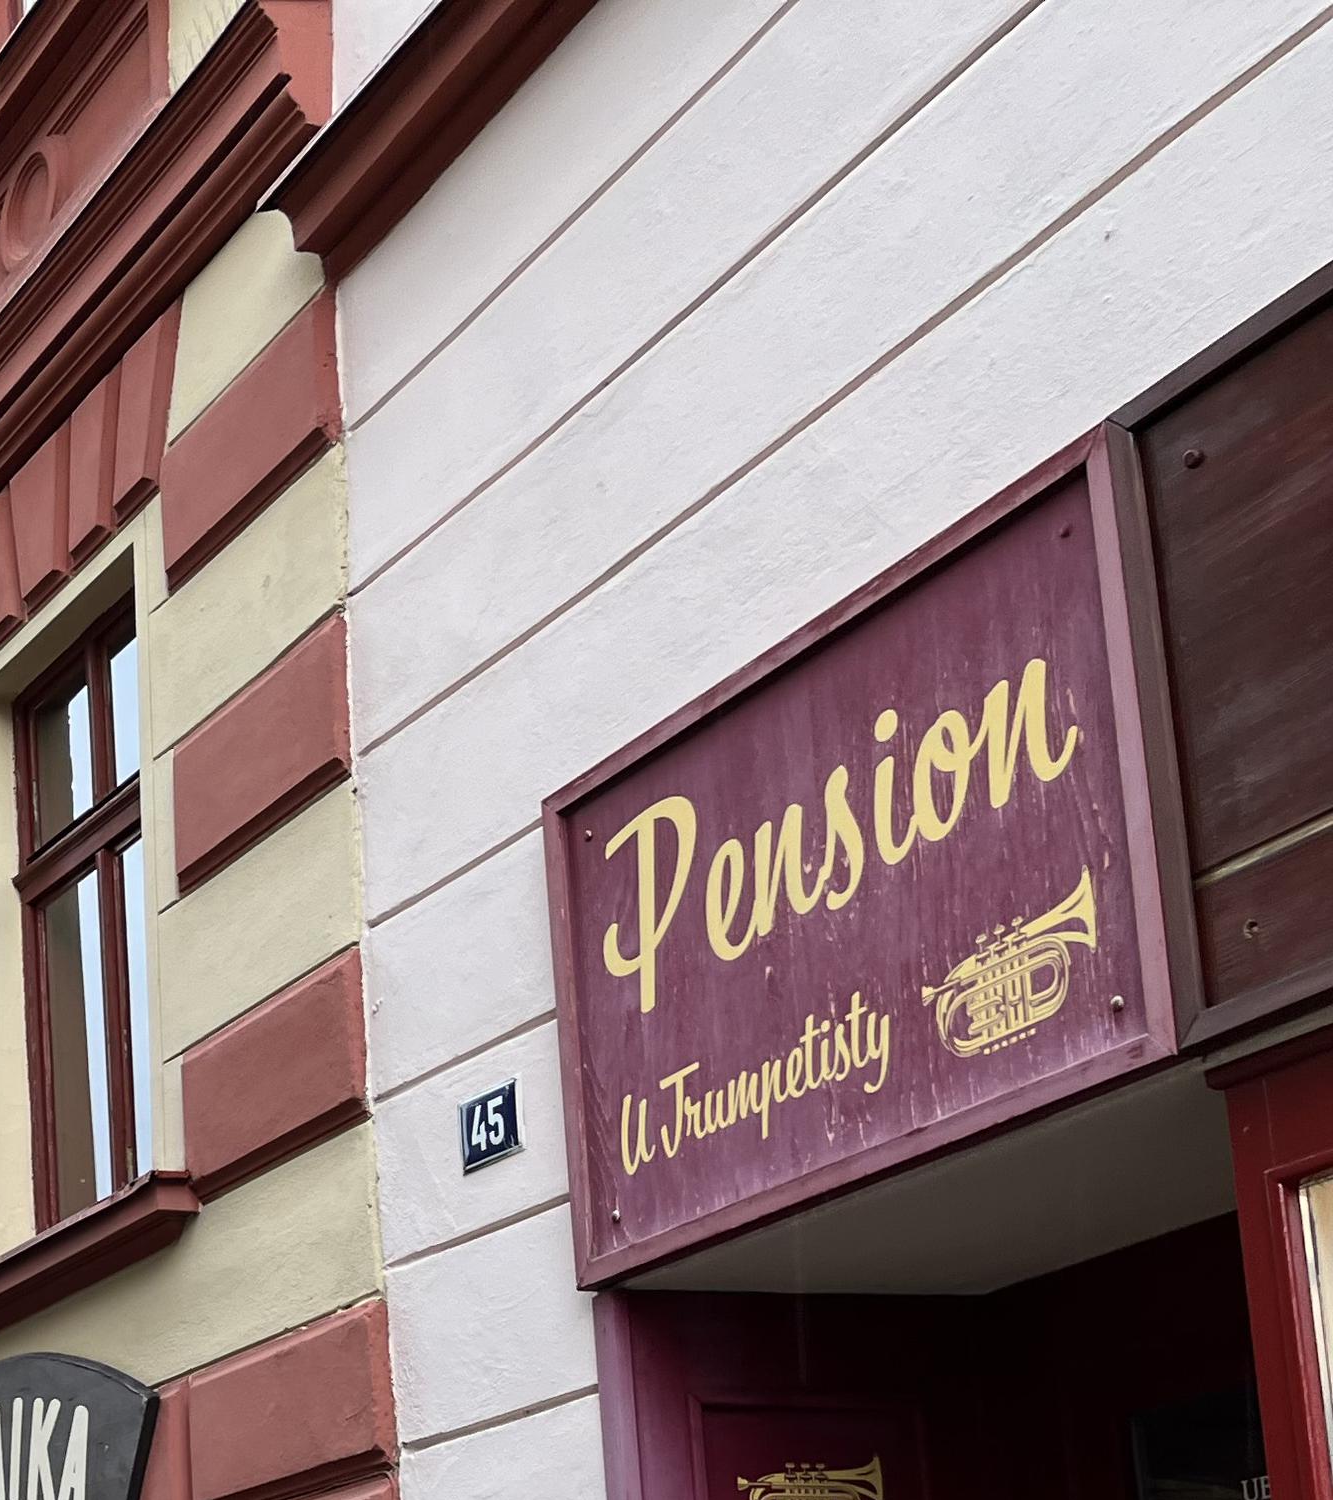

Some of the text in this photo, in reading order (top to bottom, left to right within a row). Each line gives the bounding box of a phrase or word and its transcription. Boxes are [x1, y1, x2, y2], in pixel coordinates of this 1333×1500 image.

[602, 657, 1079, 1014] Pension
[469, 1097, 506, 1149] 45
[619, 991, 891, 1177] U Trumpetisty
